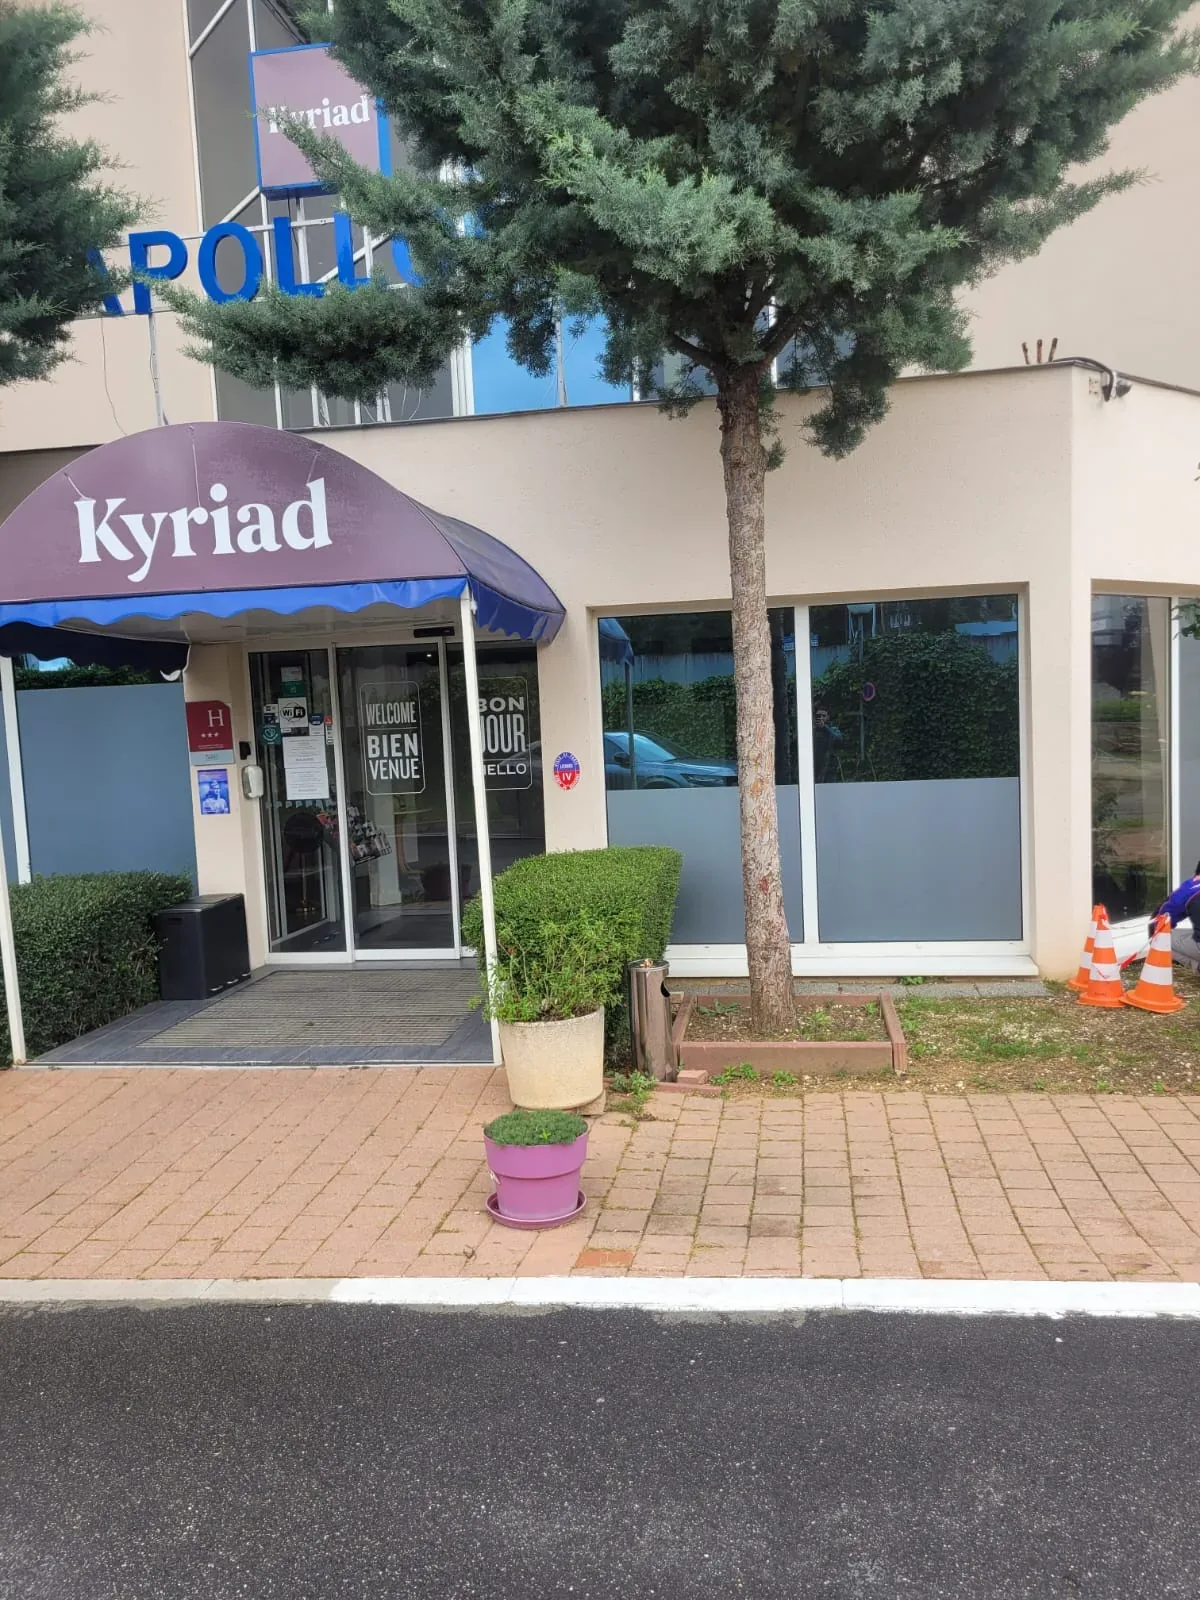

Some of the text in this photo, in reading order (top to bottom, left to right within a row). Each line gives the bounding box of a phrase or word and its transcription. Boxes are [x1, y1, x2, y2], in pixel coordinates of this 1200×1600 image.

[74, 477, 333, 583] Kyriad
[208, 708, 224, 728] H
[365, 701, 417, 726] WELCOME
[367, 733, 418, 758] BIEN
[368, 758, 420, 780] VENUE
[562, 772, 572, 781] IV
